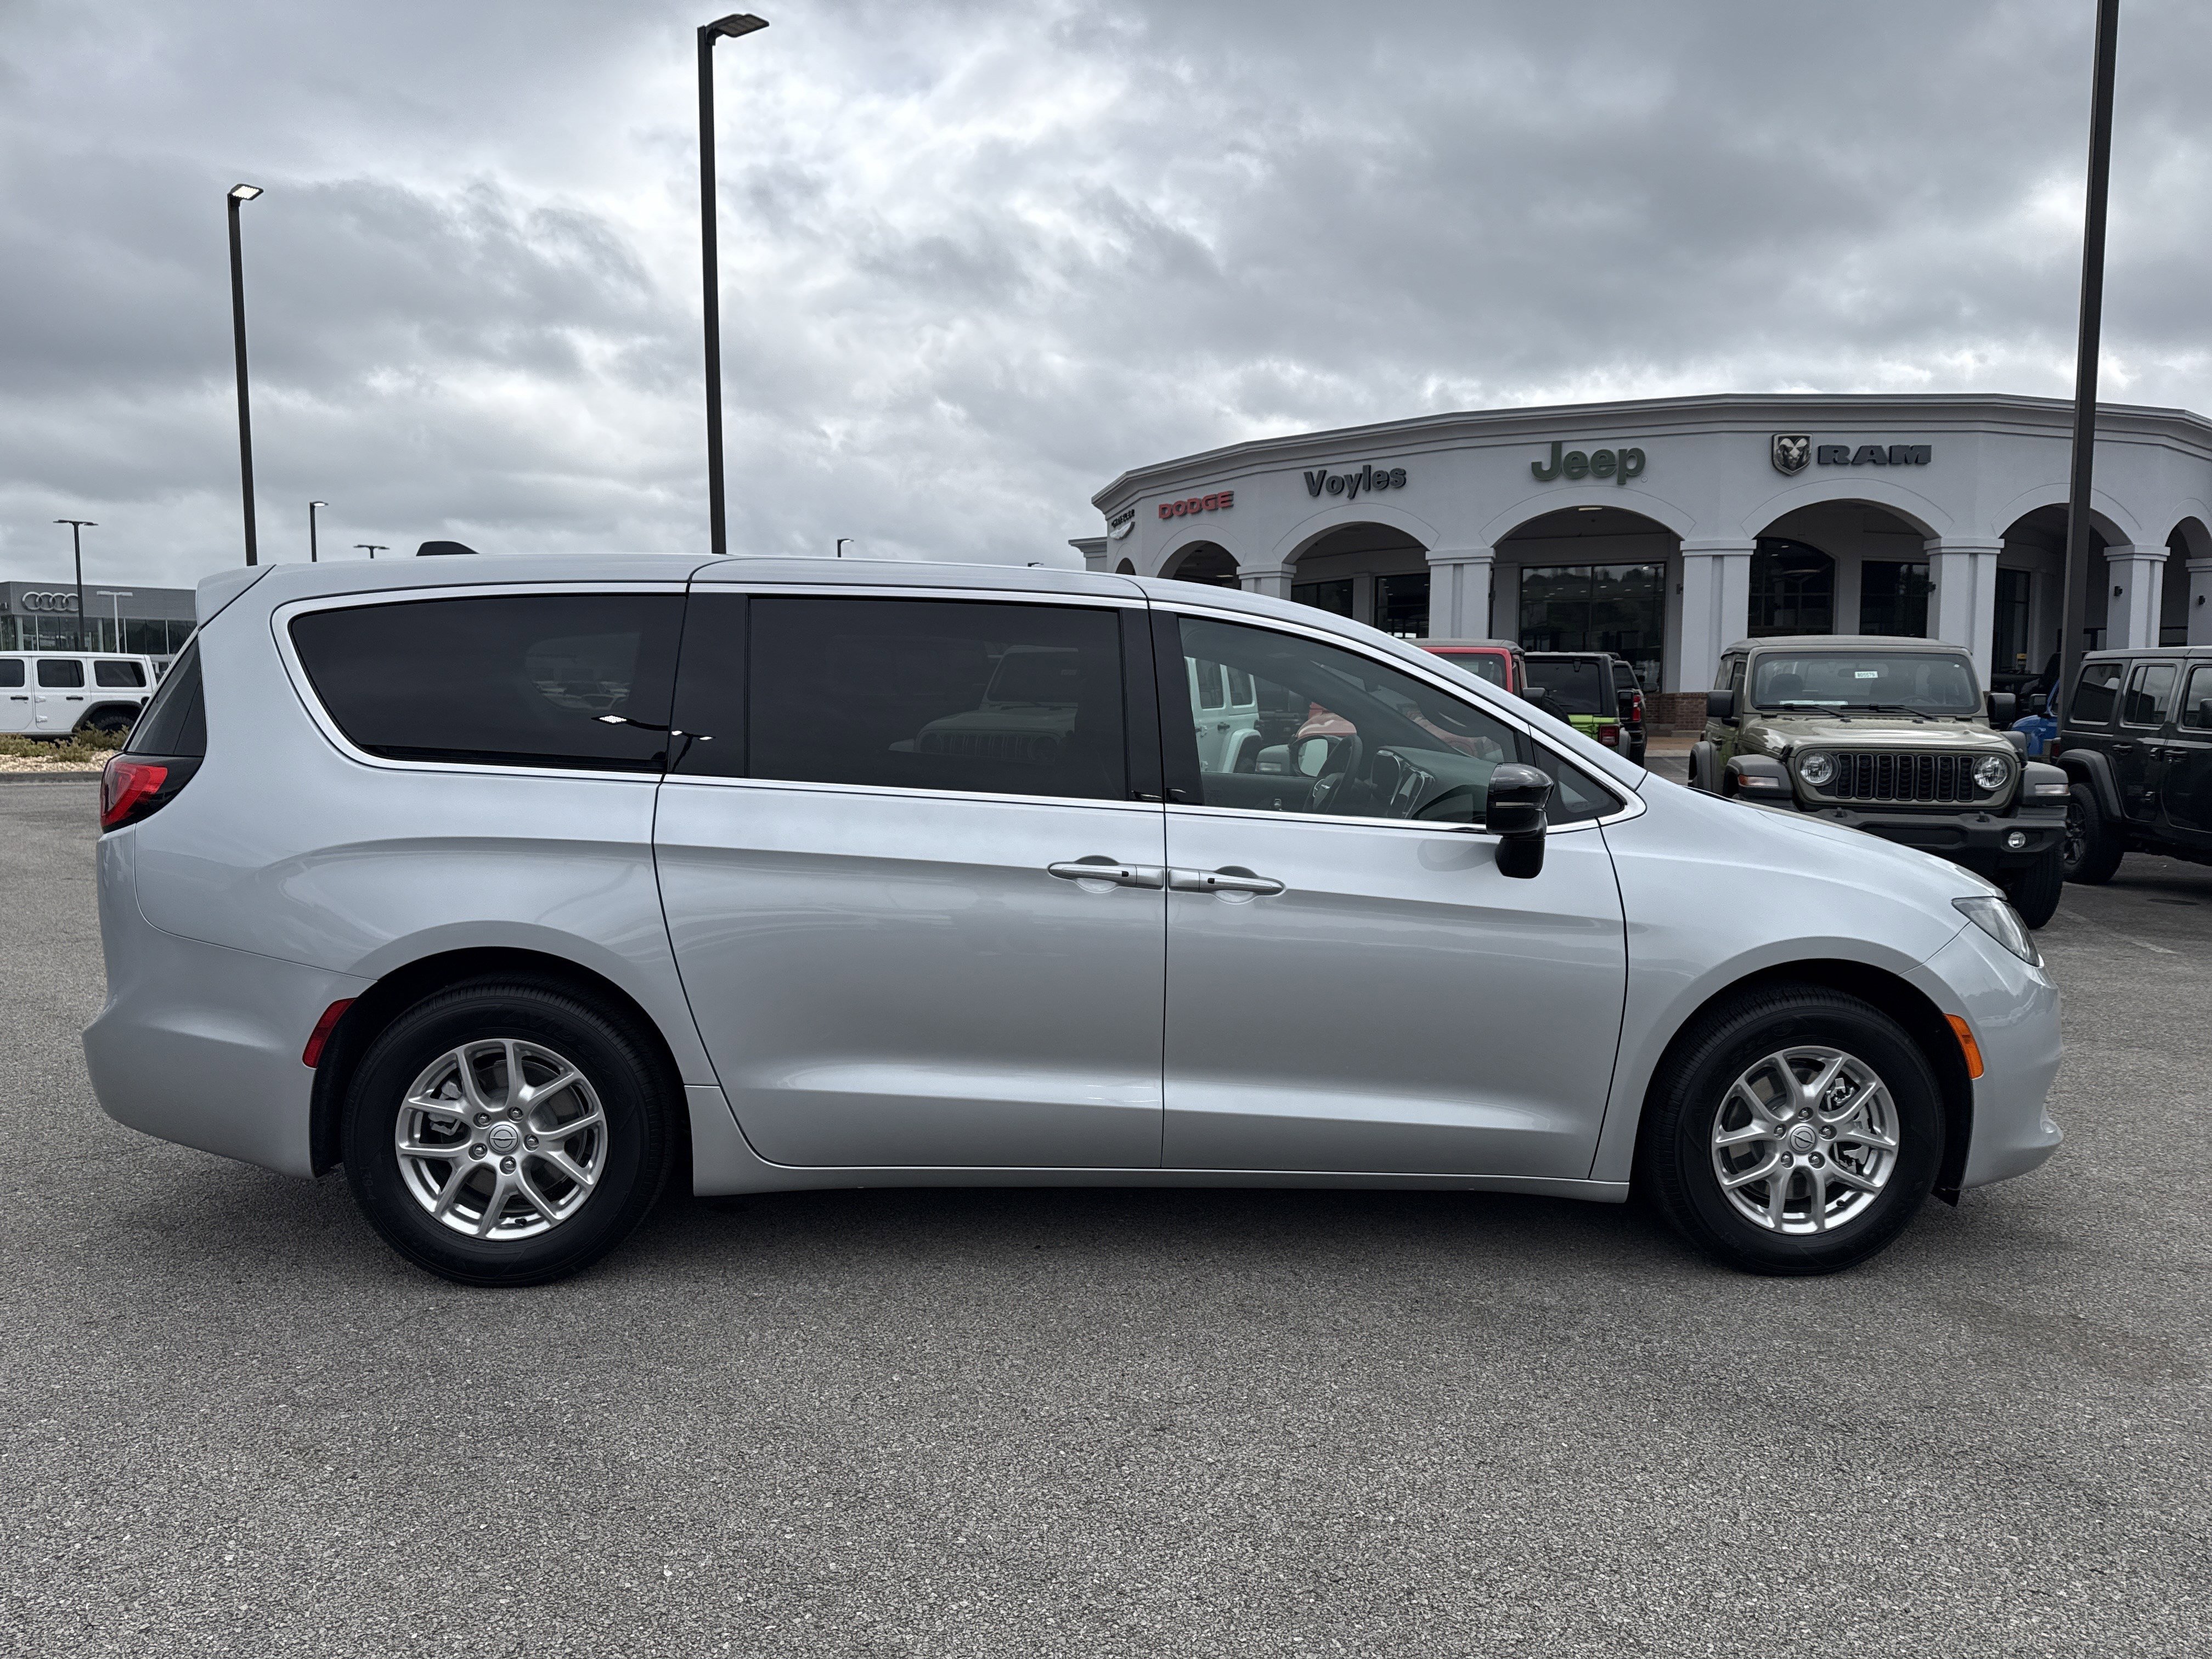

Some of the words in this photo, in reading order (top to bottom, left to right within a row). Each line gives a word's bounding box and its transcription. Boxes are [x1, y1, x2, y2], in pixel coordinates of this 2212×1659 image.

[1531, 441, 1646, 485] Jeep
[1818, 444, 1932, 465] RAM
[1304, 465, 1407, 500] Voyles
[1159, 490, 1234, 519] DODGE
